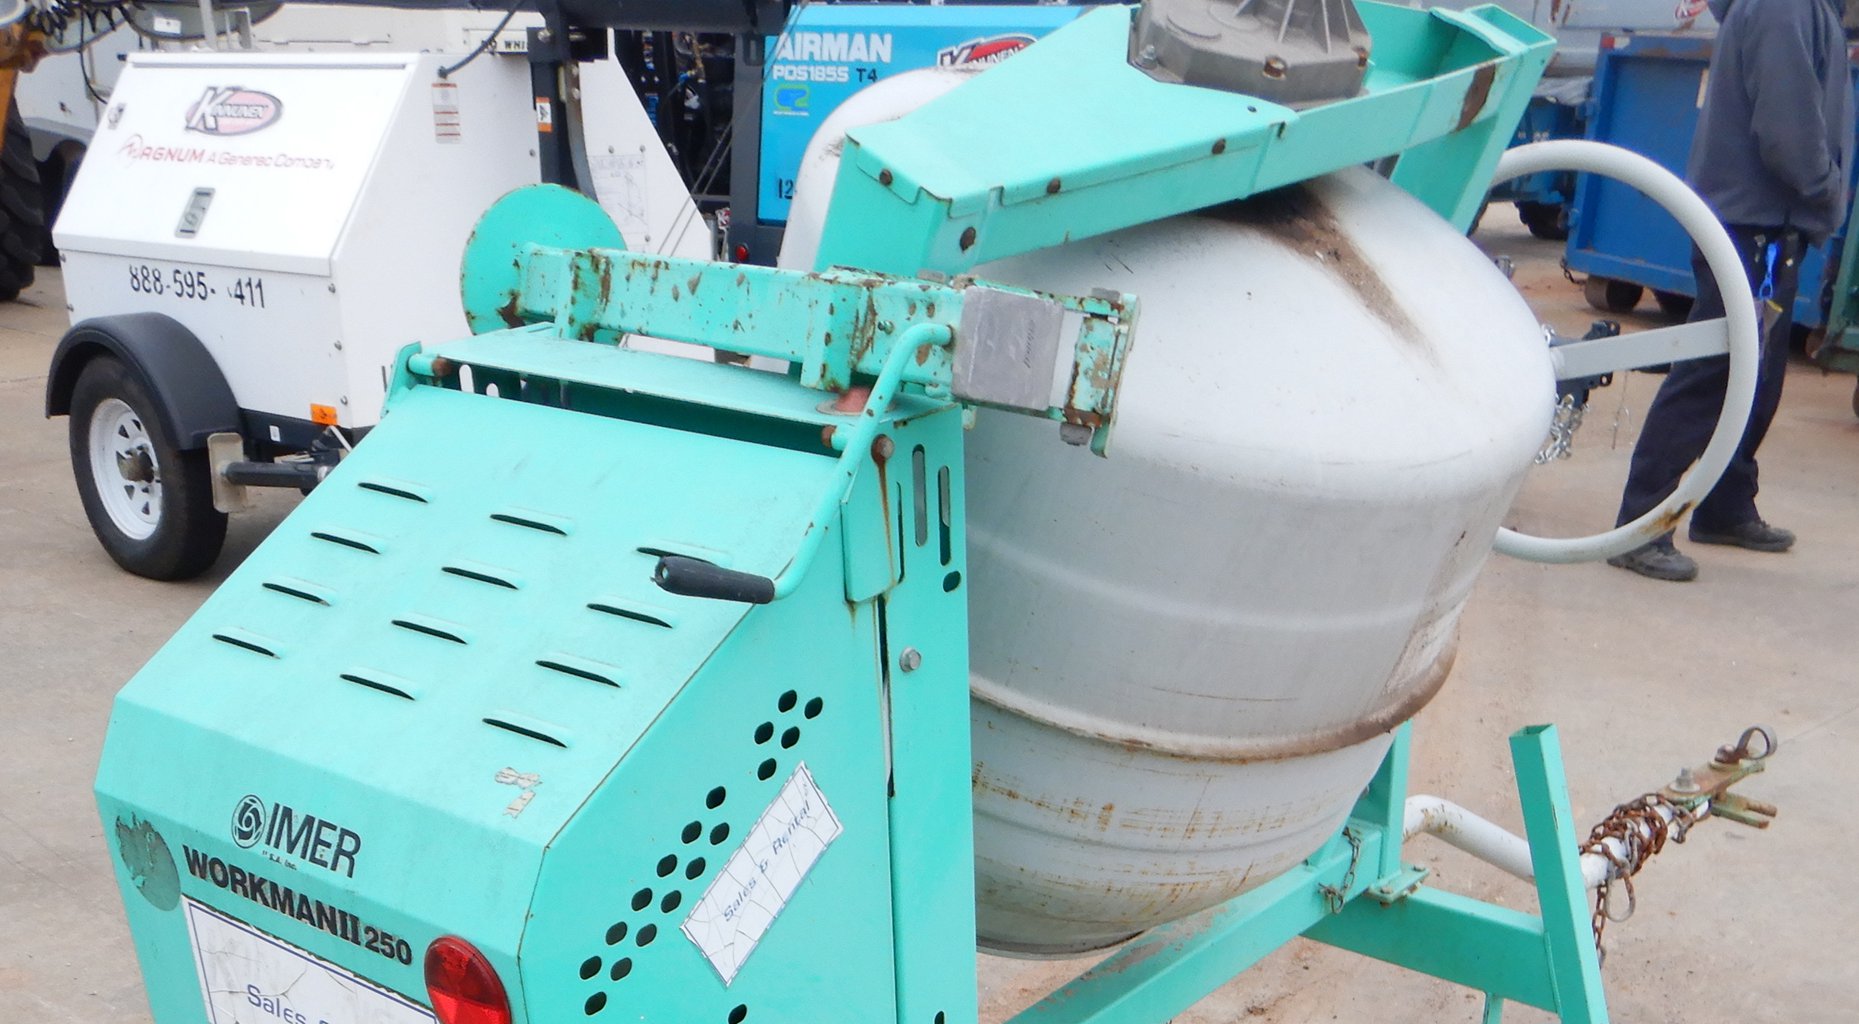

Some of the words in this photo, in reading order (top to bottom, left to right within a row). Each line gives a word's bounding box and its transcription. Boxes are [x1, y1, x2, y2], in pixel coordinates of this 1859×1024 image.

[777, 32, 892, 63] AIRMAN
[856, 68, 878, 82] T4
[129, 264, 265, 308] 888-595-411
[265, 802, 361, 878] IMER
[723, 877, 757, 922] Sales
[759, 858, 769, 873] &
[772, 799, 810, 855] Rental
